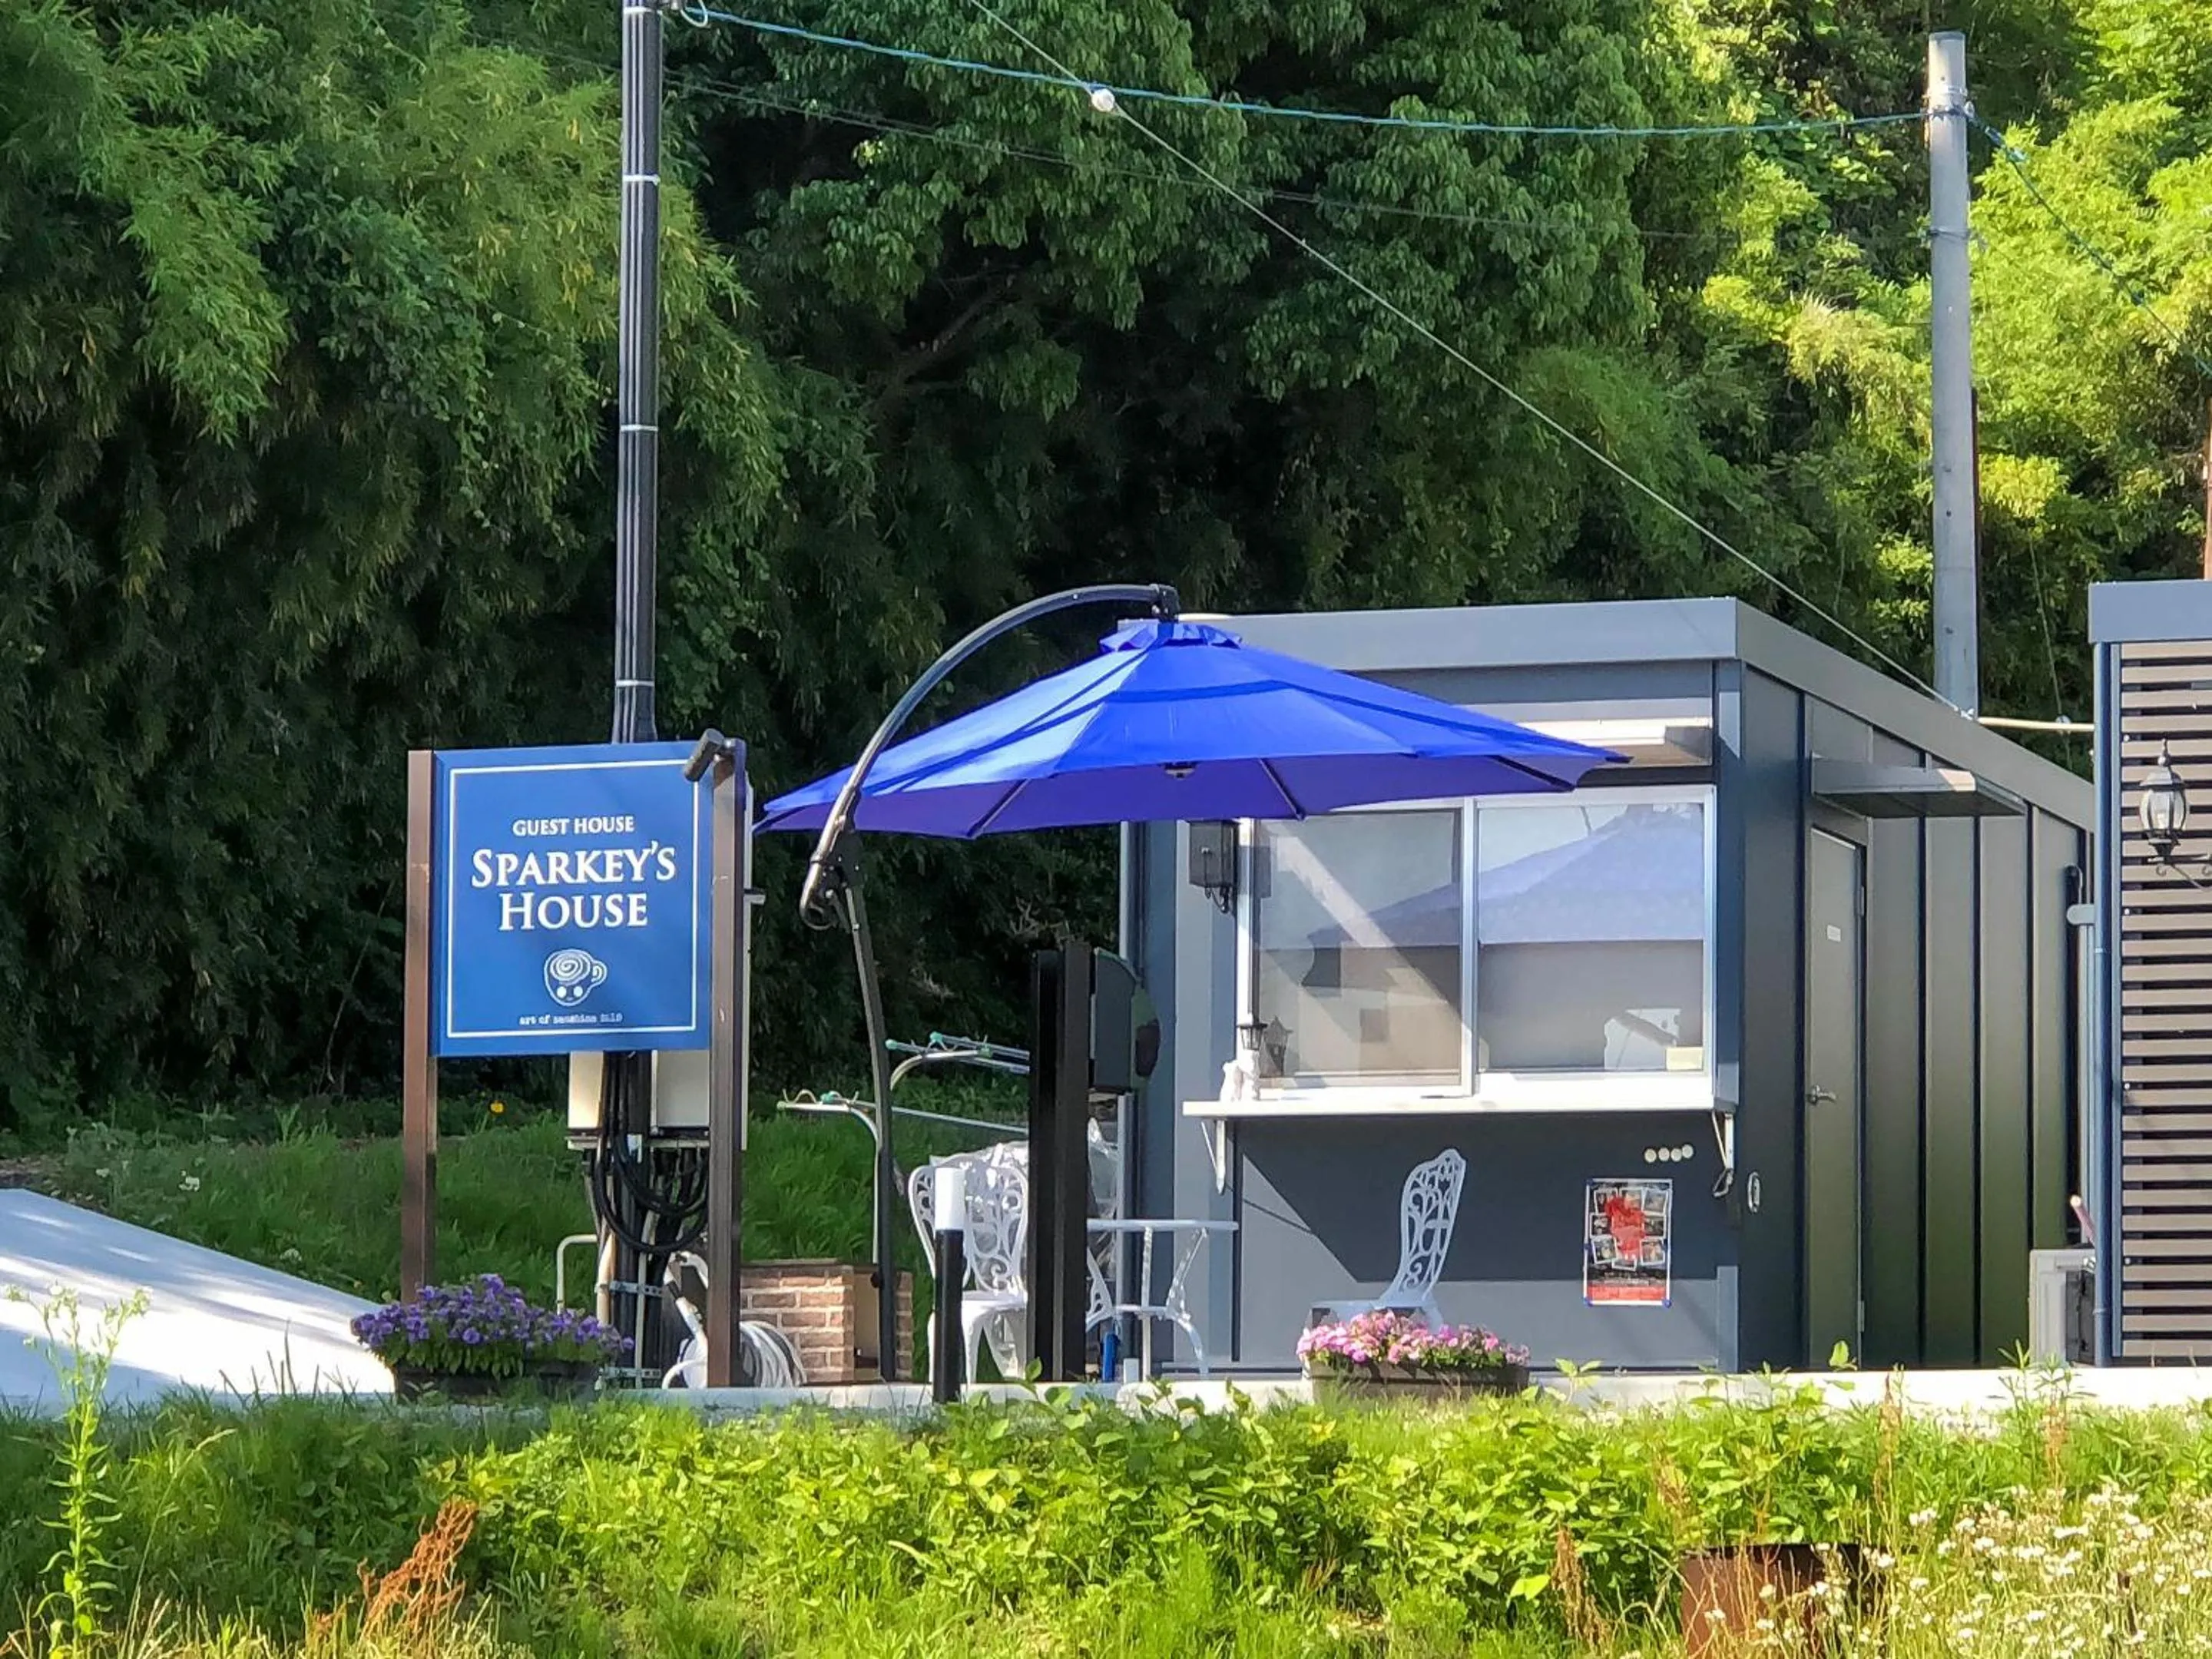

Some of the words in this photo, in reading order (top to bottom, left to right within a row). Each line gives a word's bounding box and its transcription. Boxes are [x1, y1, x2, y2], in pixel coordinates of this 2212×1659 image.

[512, 819, 570, 836] GUEST
[574, 816, 635, 834] HOUSE
[471, 840, 677, 888] SPARKEY'S
[498, 892, 648, 931] HOUSE
[538, 1014, 551, 1025] of
